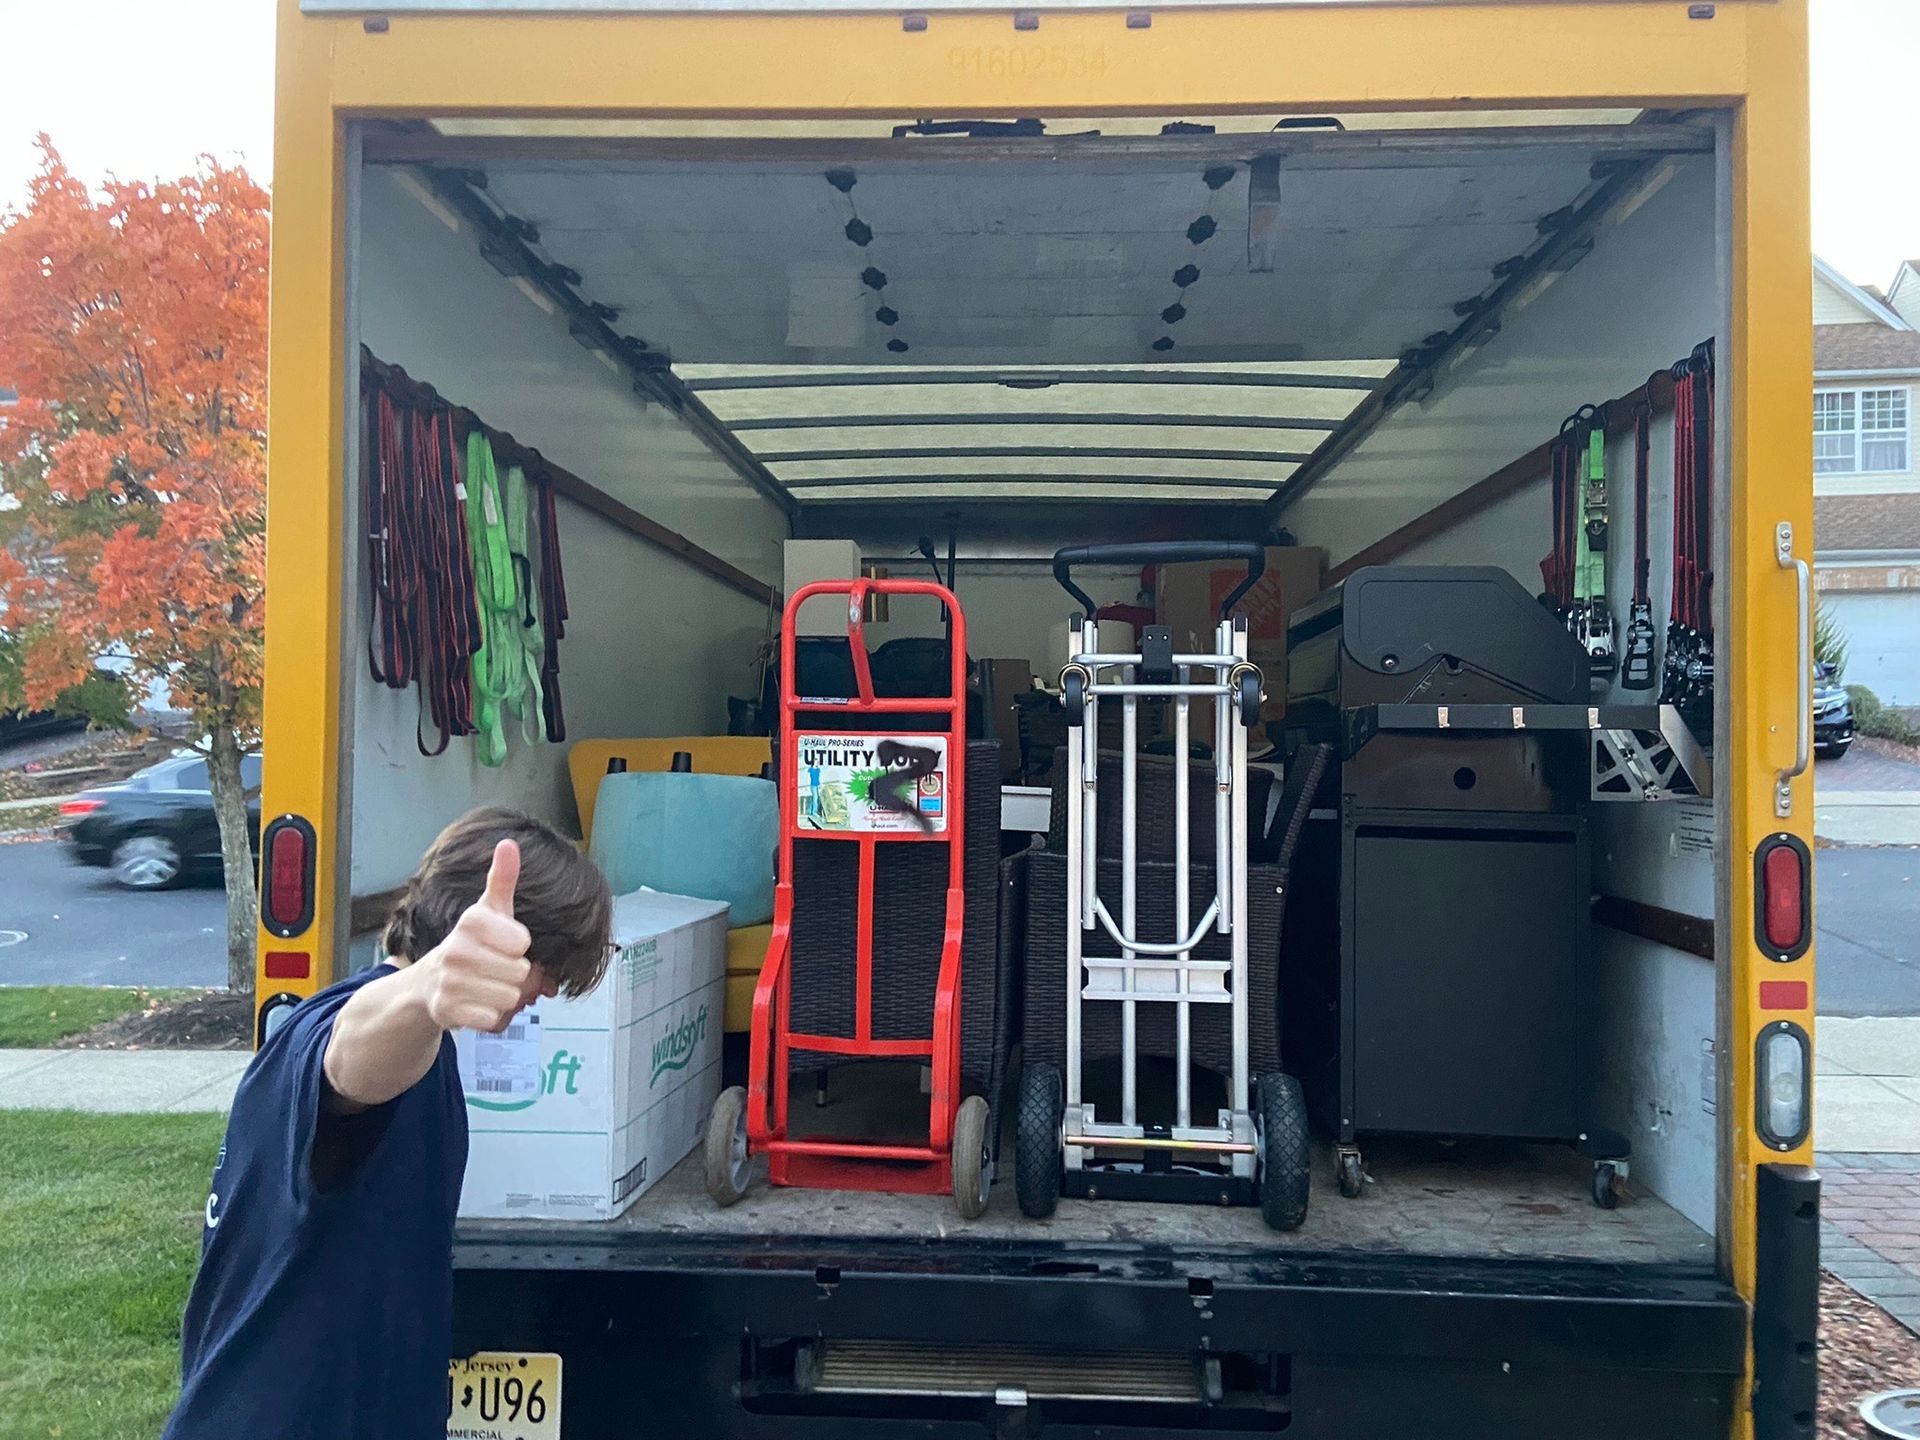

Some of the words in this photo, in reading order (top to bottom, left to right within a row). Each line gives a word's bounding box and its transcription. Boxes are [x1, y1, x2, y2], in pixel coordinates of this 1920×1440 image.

[946, 44, 1107, 78] 91602534
[804, 738, 826, 748] U-HAUL
[828, 739, 864, 747] PRO-SERIES
[804, 749, 875, 767] UTILITY
[463, 1357, 514, 1375] Jersey
